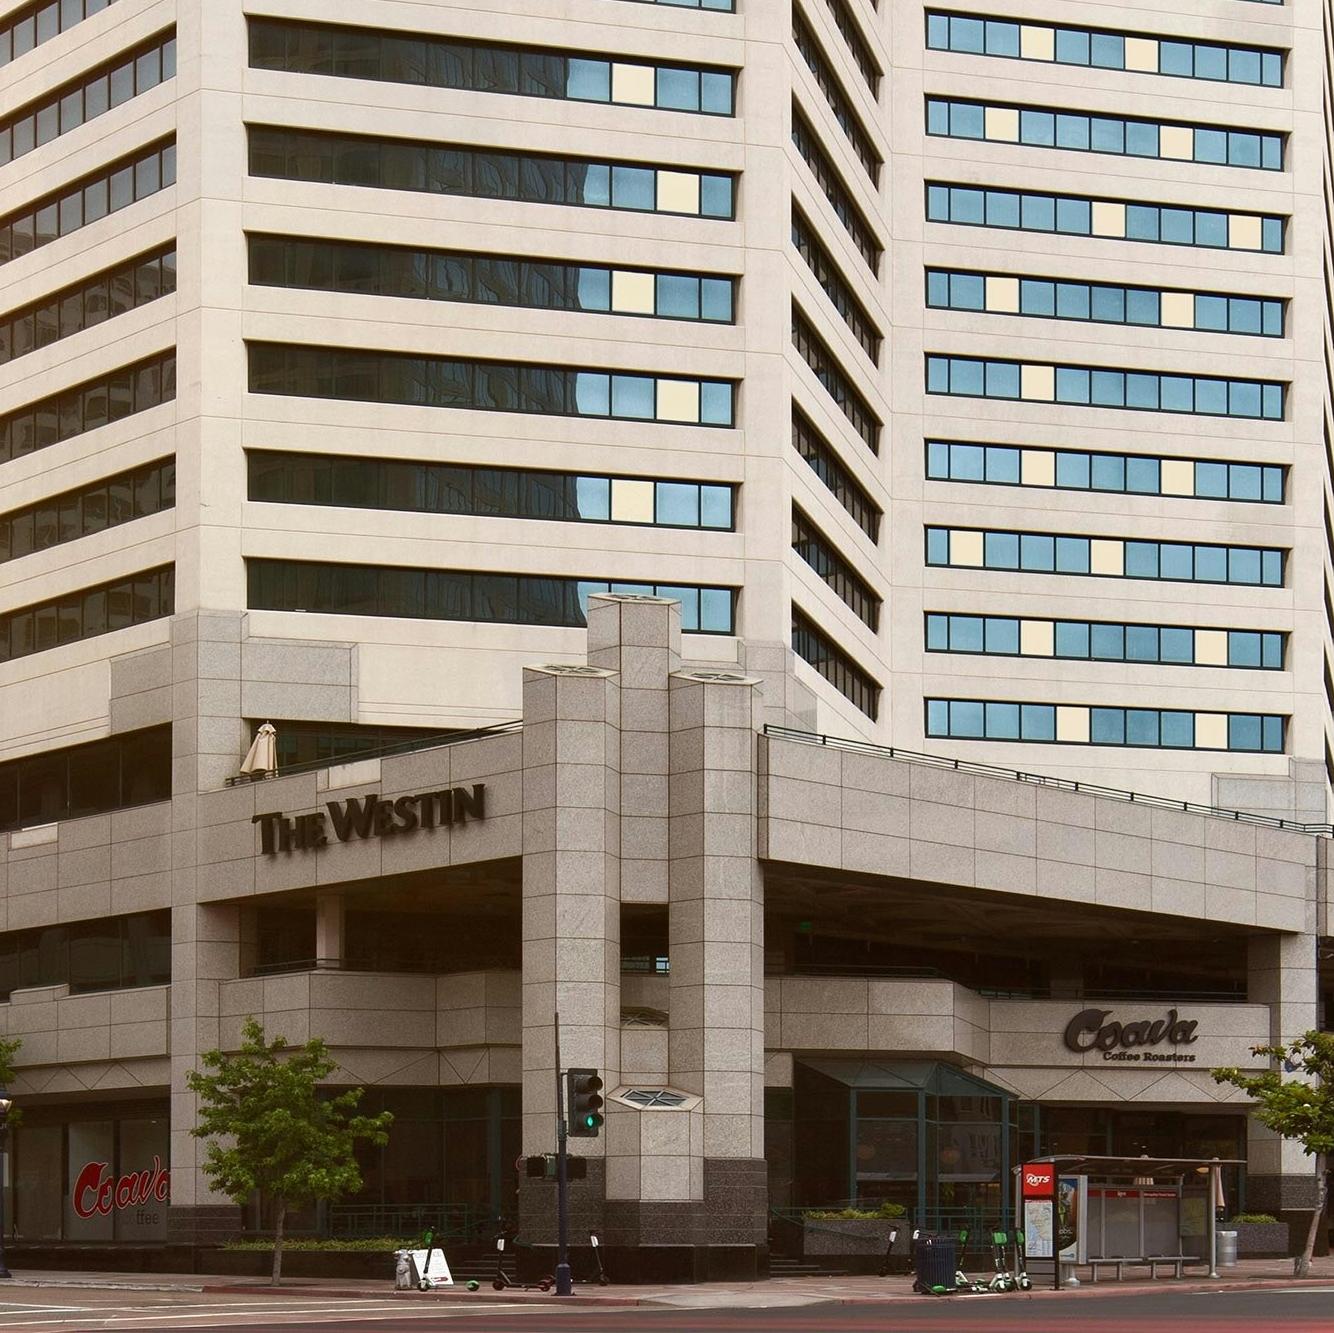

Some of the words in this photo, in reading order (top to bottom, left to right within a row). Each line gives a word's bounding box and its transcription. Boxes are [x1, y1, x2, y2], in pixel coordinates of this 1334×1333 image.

[251, 811, 328, 855] THE
[326, 783, 485, 843] WESTIN
[1103, 1051, 1141, 1062] Coffee
[1143, 1052, 1196, 1063] Roasters
[1026, 1174, 1051, 1185] MTS
